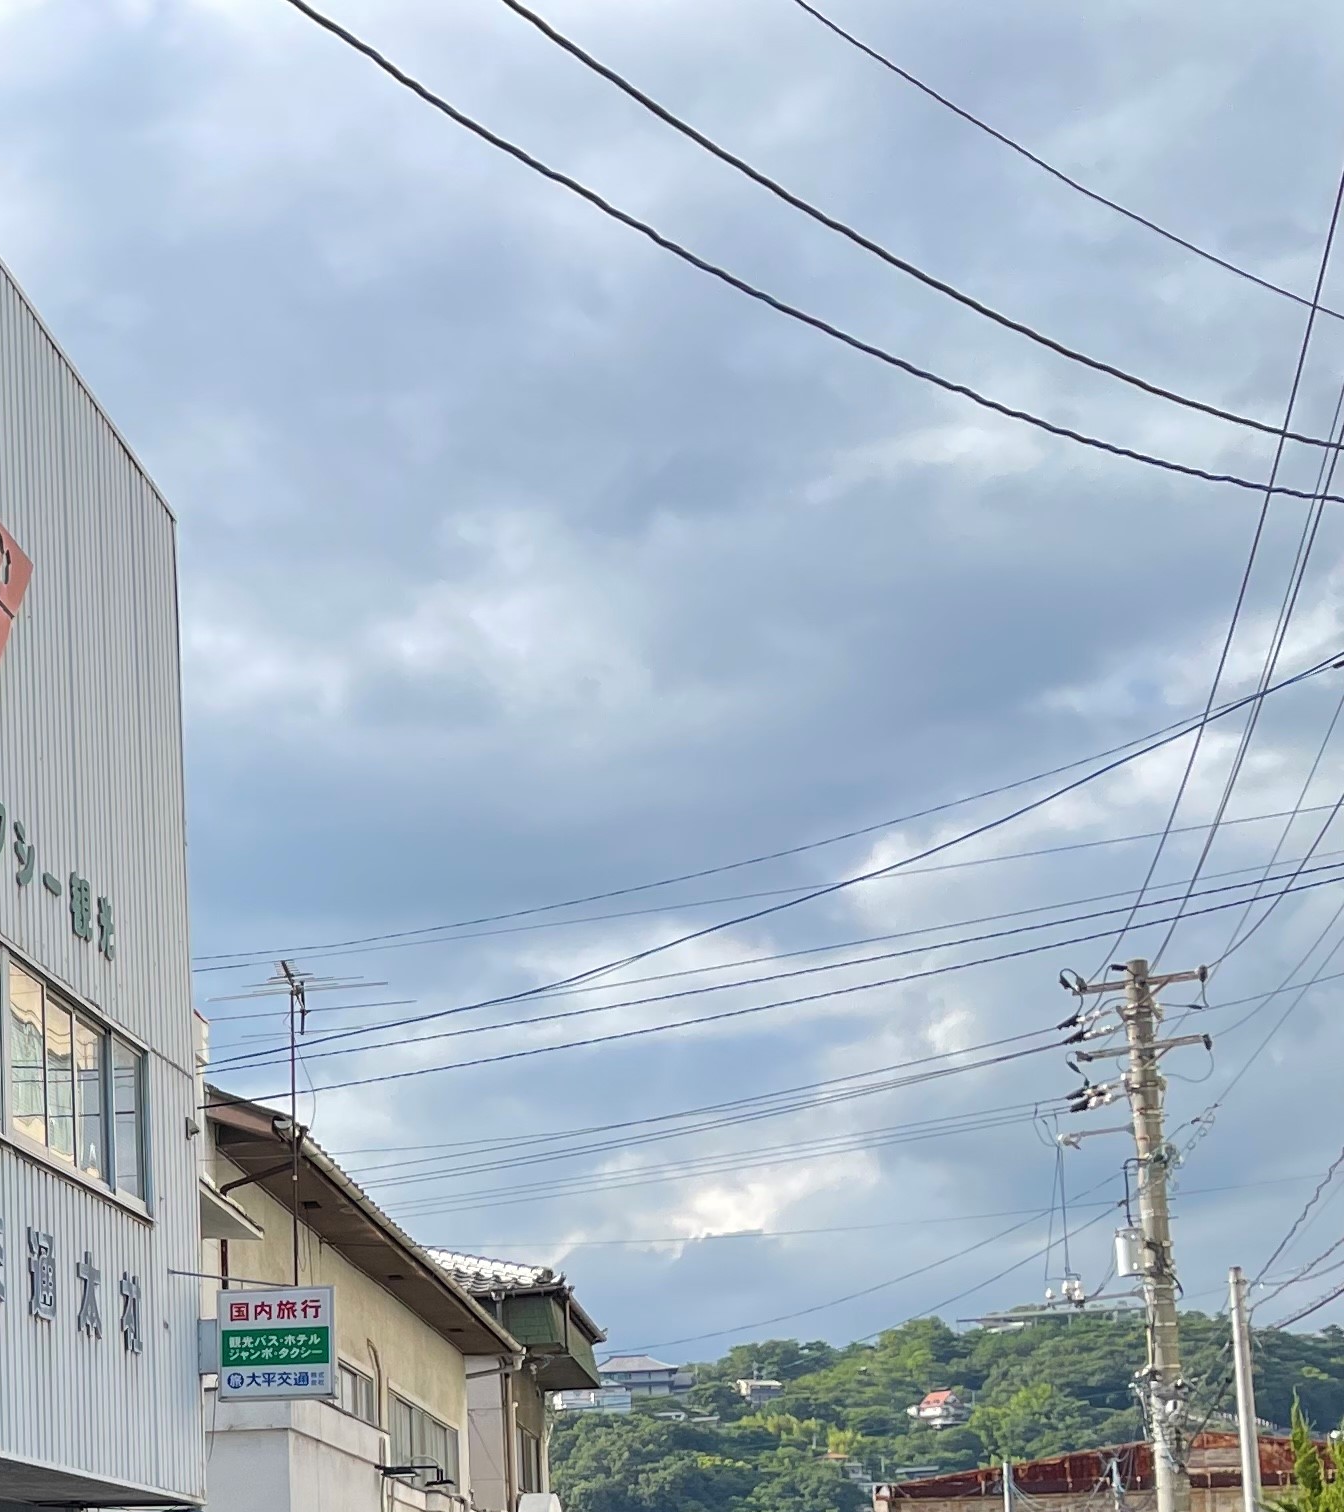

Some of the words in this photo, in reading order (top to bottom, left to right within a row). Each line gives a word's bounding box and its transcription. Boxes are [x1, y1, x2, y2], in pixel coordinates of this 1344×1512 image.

[230, 1299, 321, 1321] 国内旅行
[246, 1372, 309, 1387] 大平交通
